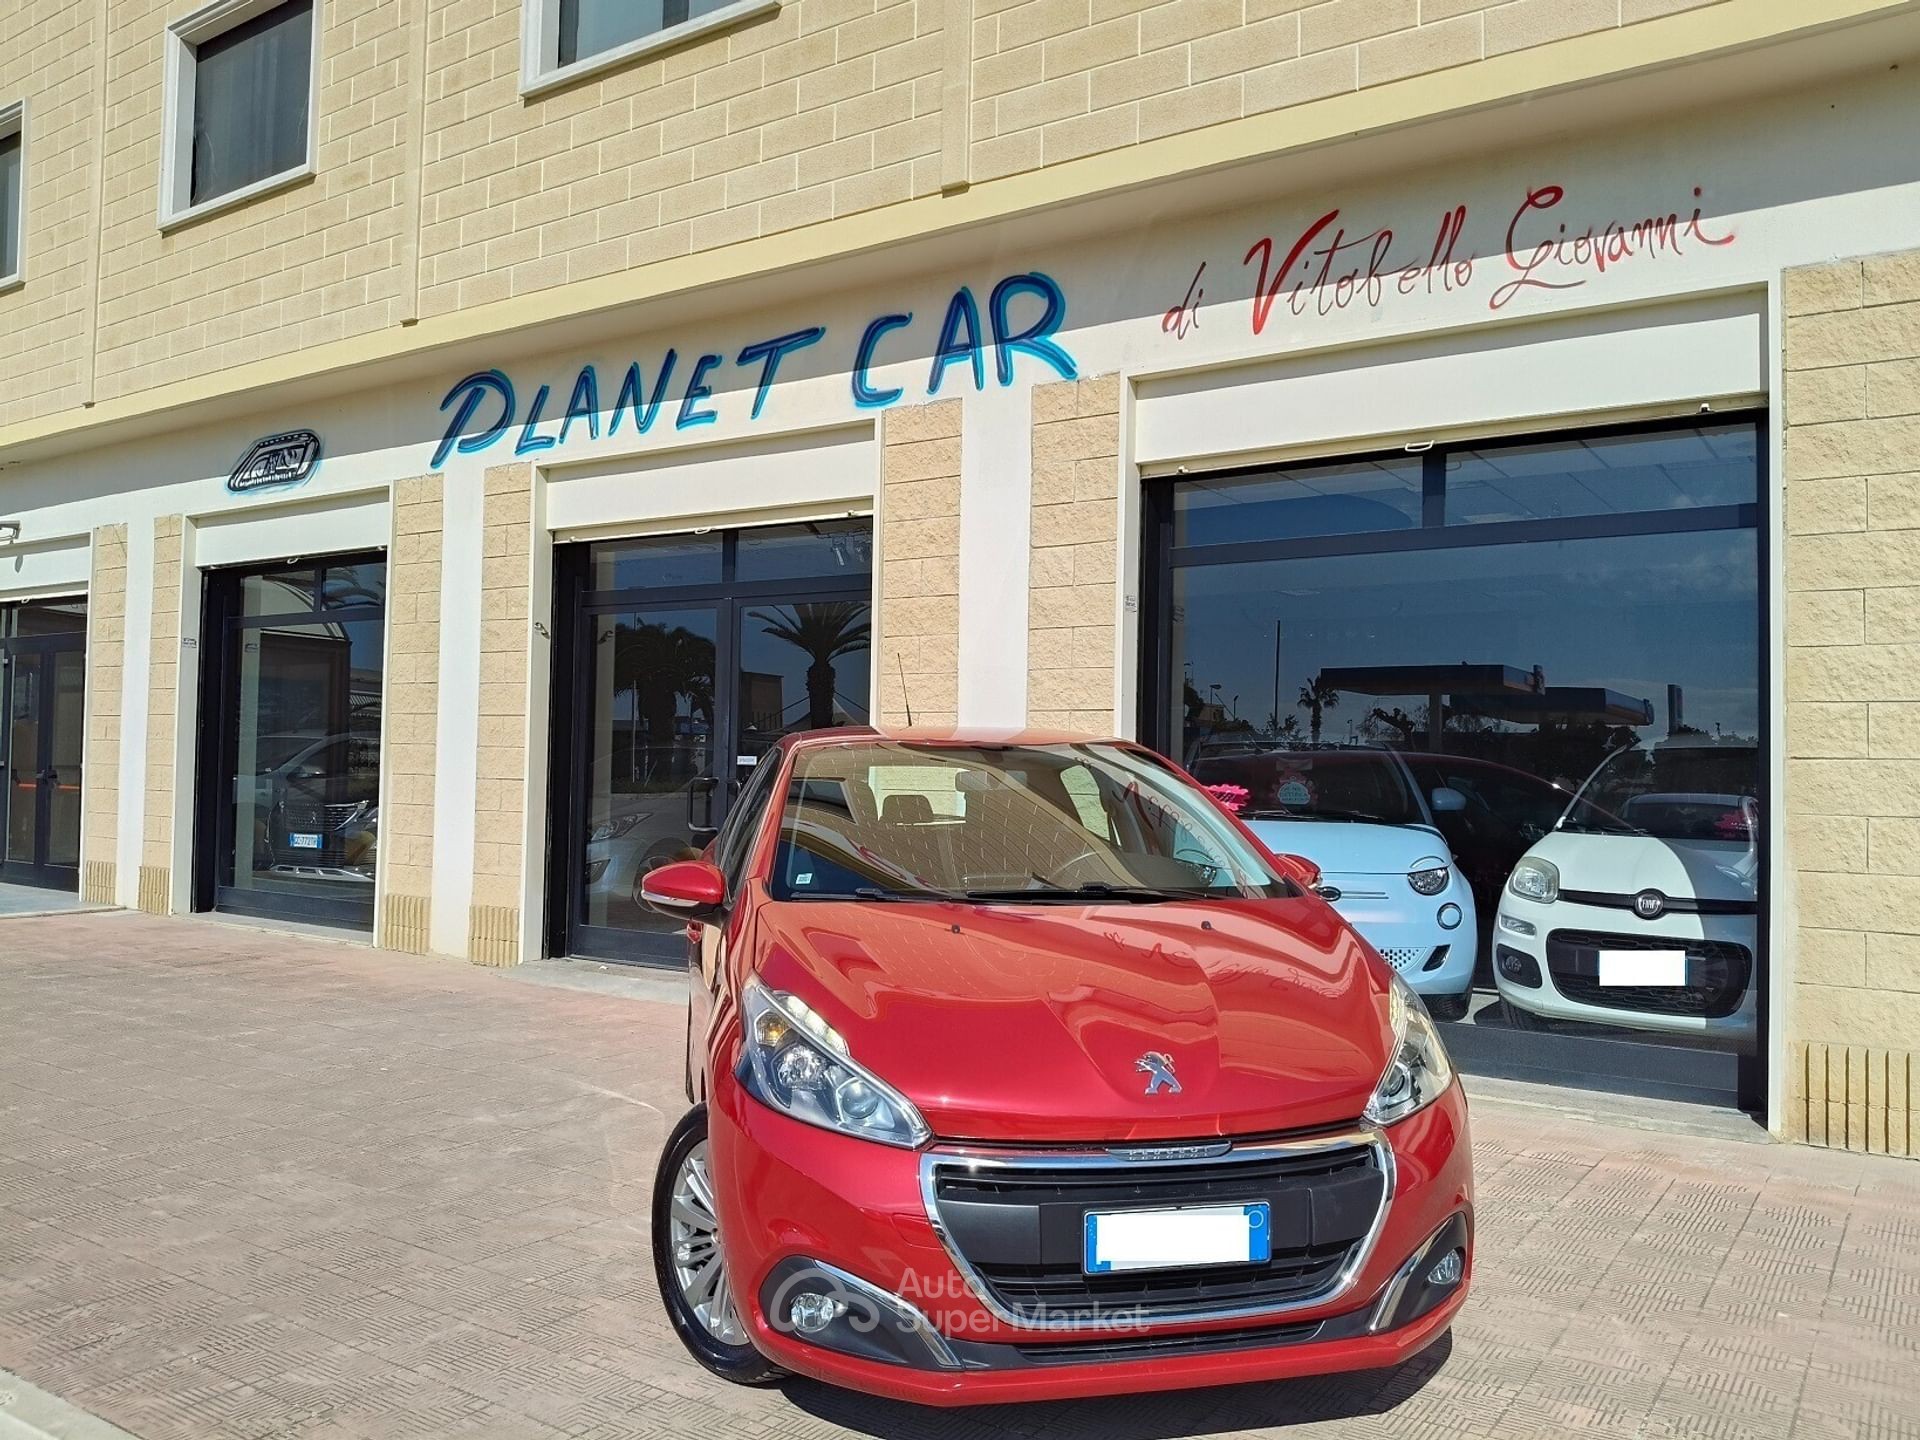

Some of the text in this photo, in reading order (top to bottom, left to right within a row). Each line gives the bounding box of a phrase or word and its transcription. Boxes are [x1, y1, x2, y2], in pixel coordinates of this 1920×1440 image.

[1161, 185, 1735, 341] di Vitobello Giovanni
[429, 271, 1078, 468] PLANET CAR
